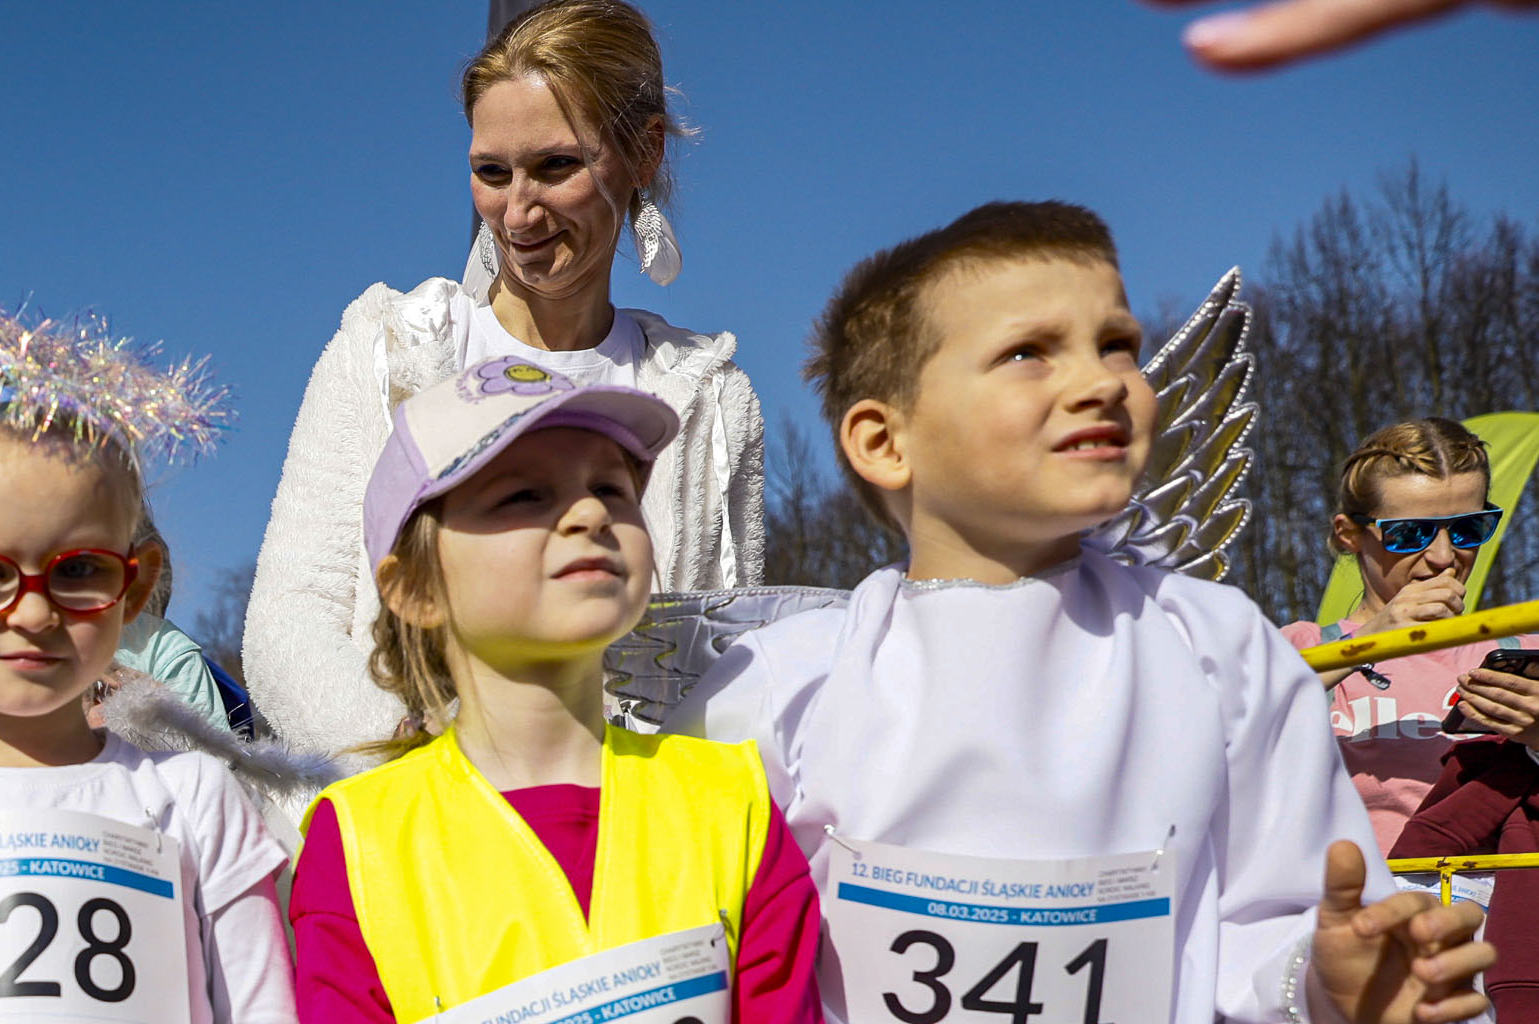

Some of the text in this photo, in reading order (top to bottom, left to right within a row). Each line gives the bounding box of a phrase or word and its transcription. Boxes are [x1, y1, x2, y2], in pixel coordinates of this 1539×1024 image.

[1330, 696, 1485, 742] elle
[50, 833, 101, 852] ANIOŁY
[29, 859, 105, 880] KATOWICE
[851, 863, 868, 877] 12.
[872, 866, 903, 884] BIEG
[906, 872, 978, 895] FUNDACJI
[982, 879, 1041, 900] ŚLĄSKIE
[1045, 881, 1095, 898] ANIOŁY
[927, 902, 1009, 922] 08.03.2025
[1020, 910, 1098, 923] KATOWICE
[552, 980, 610, 1009] ŚLĄSKIE
[612, 962, 662, 988] ANIOŁY
[601, 987, 677, 1020] KATOWICE
